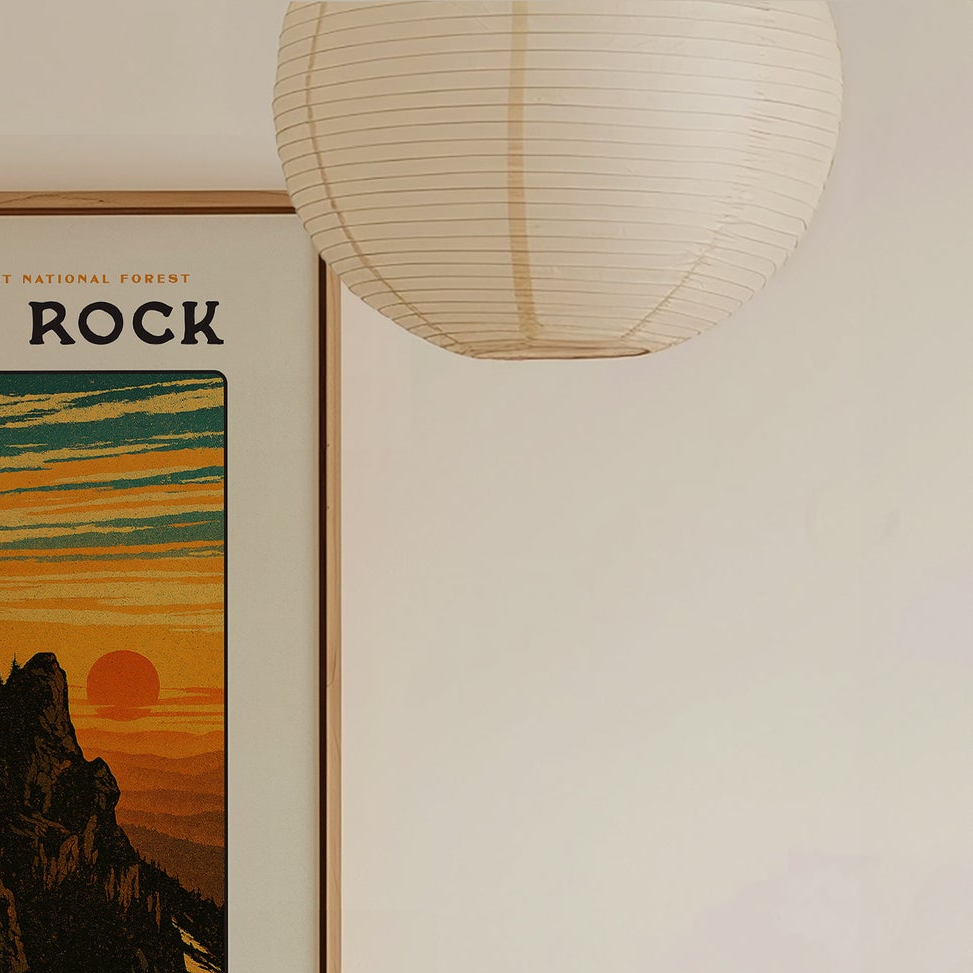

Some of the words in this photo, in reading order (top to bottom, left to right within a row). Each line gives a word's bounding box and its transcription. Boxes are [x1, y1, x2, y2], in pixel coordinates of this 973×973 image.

[22, 274, 110, 285] NATIONAL
[120, 273, 190, 284] FOREST
[28, 300, 225, 345] ROCK
